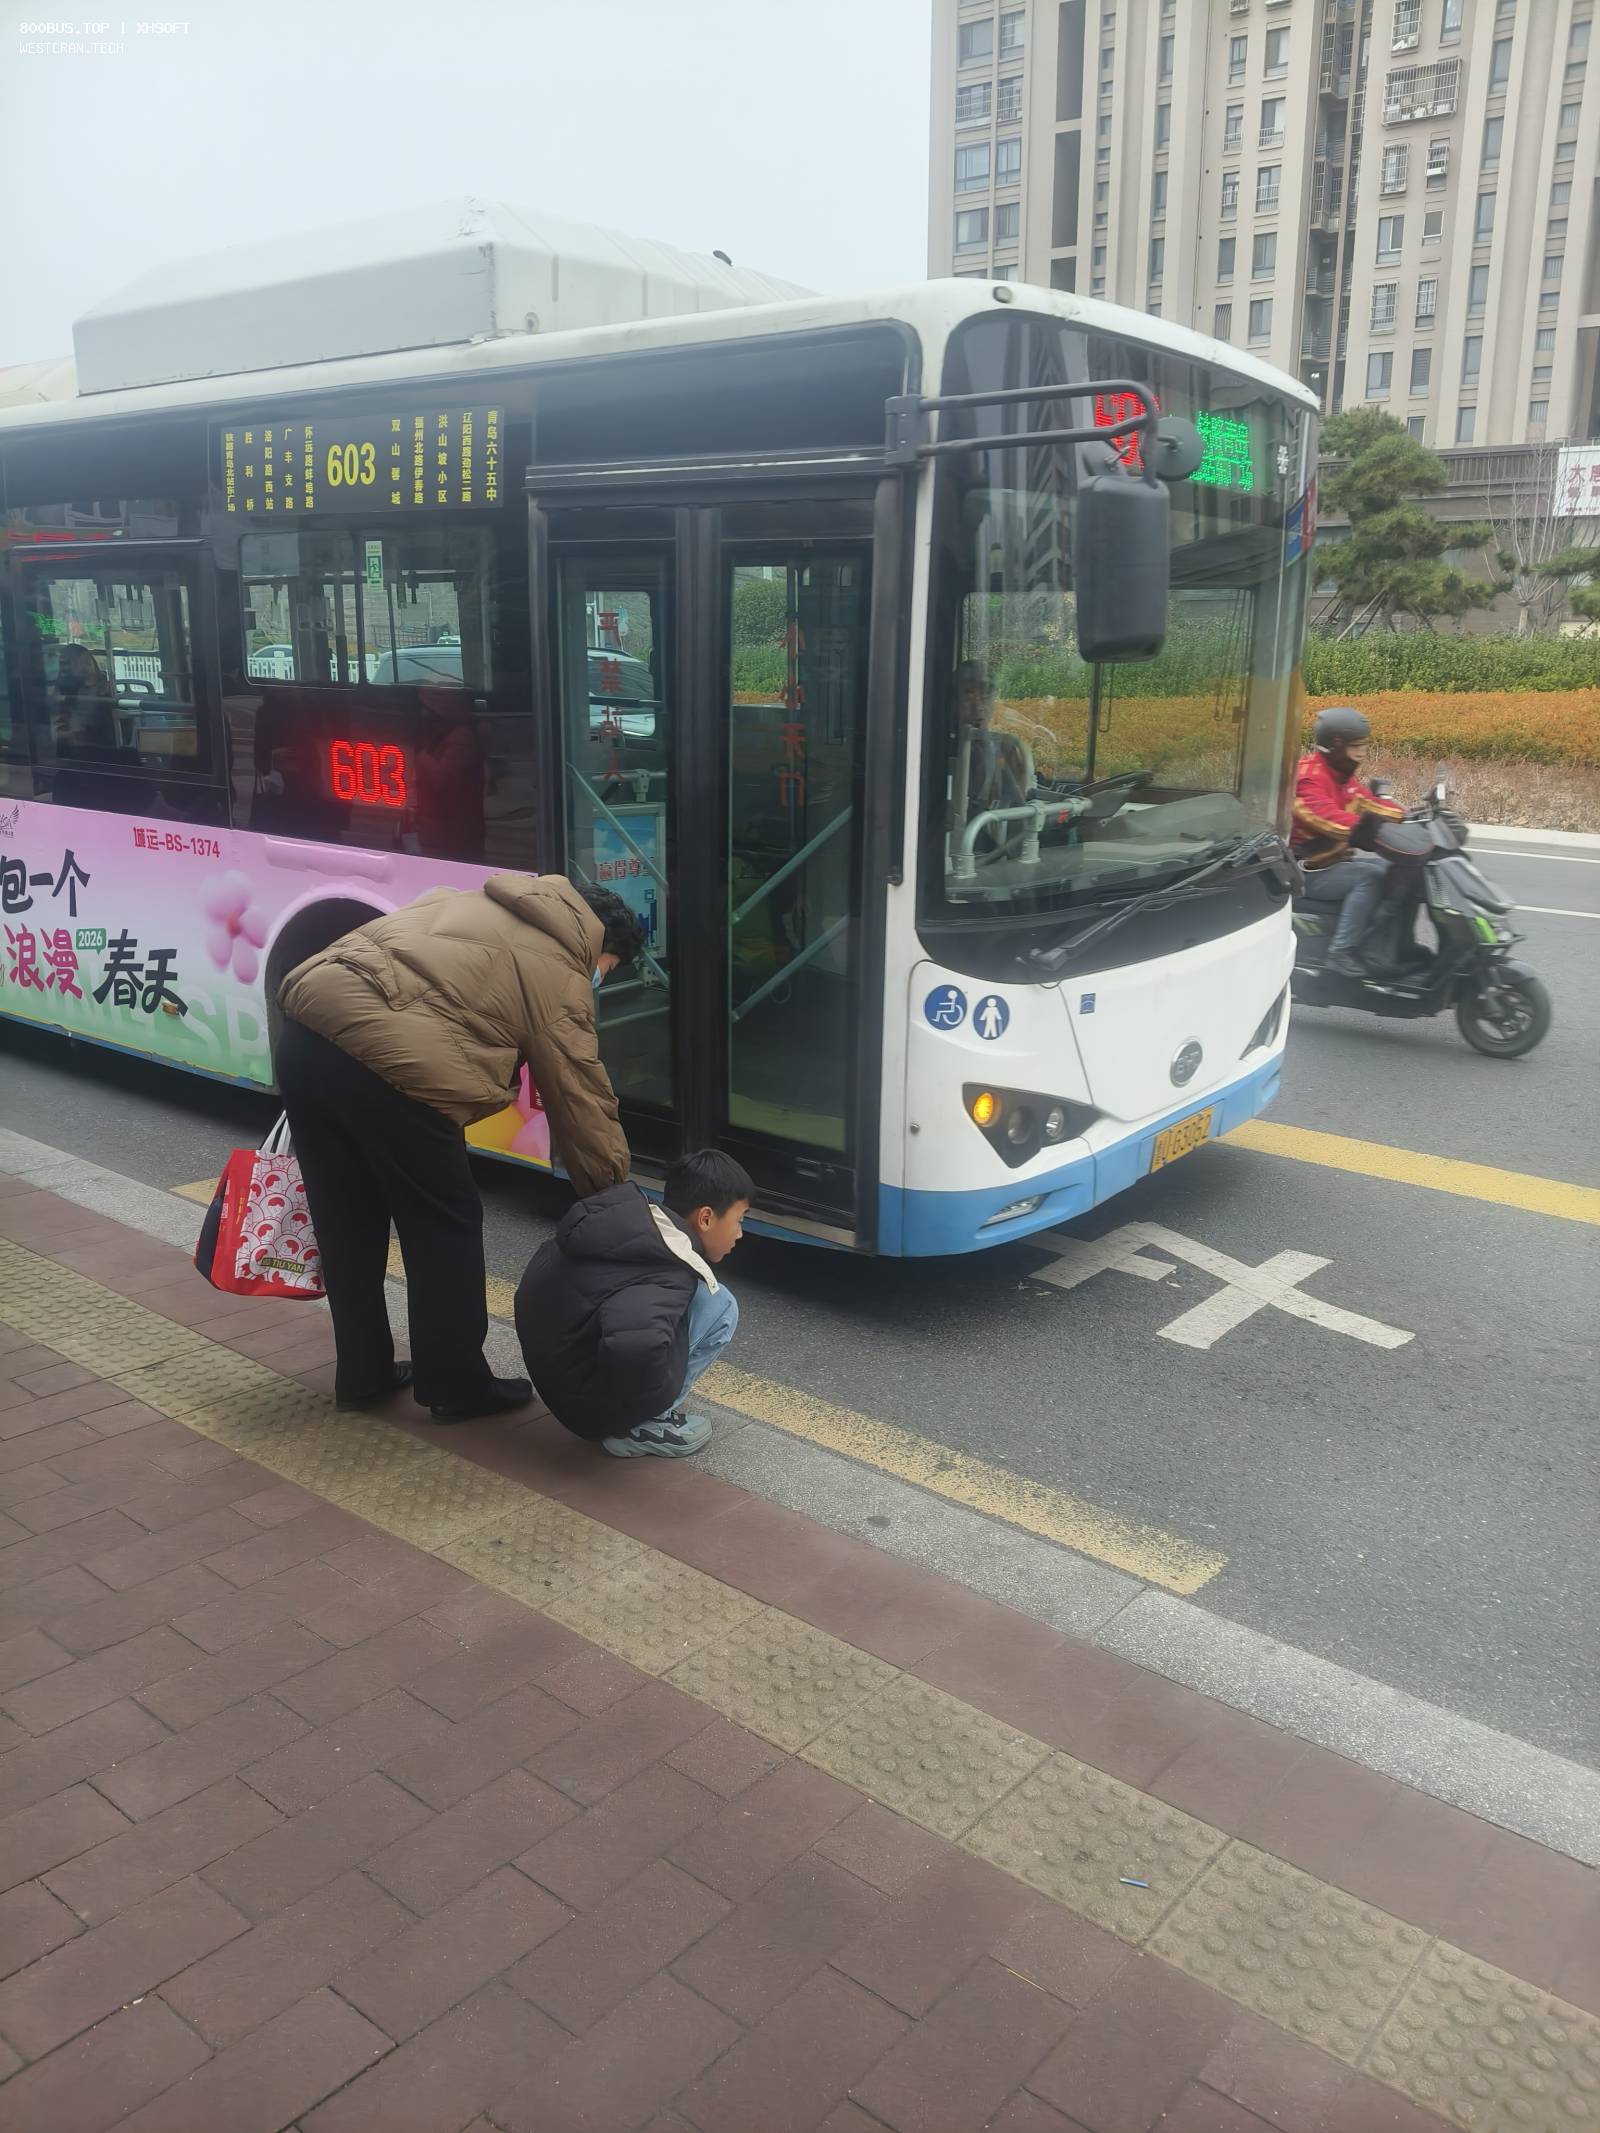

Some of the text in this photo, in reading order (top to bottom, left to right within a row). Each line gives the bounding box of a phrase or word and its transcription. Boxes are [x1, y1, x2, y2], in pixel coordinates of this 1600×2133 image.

[326, 441, 377, 487] 603
[437, 414, 448, 503] 洪山坡小区
[330, 739, 407, 806] 603
[0, 849, 91, 917] 包一个
[3, 922, 83, 1000] 浪漫
[78, 931, 103, 947] 2026
[92, 929, 188, 1017] 春天
